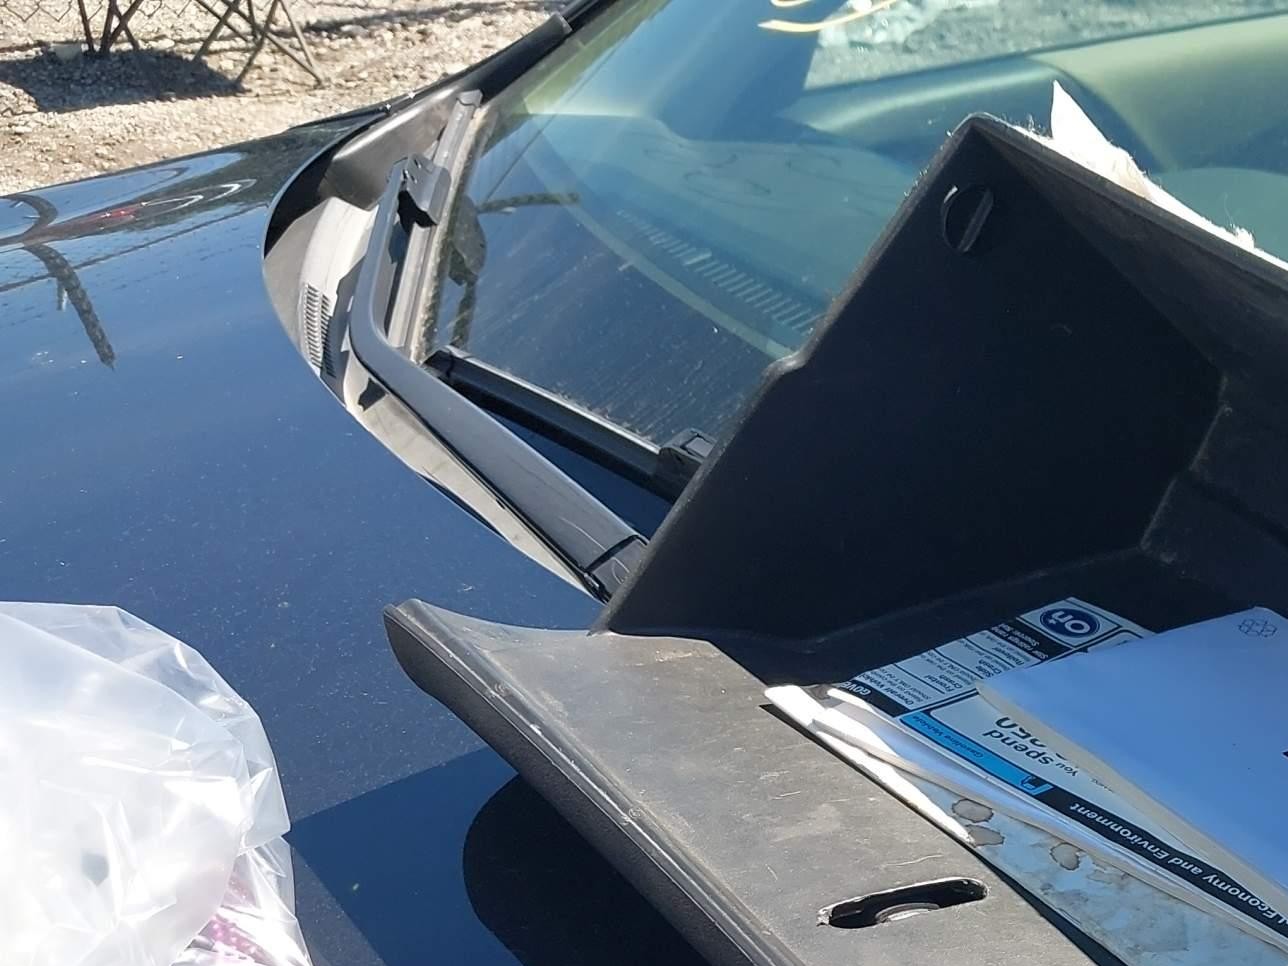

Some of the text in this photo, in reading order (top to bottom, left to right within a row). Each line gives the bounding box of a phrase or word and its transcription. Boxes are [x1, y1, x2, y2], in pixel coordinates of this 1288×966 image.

[923, 674, 955, 692] Frontal
[983, 729, 1055, 766] spend
[1056, 763, 1078, 777] You
[1069, 802, 1277, 921] Economy and Environment
